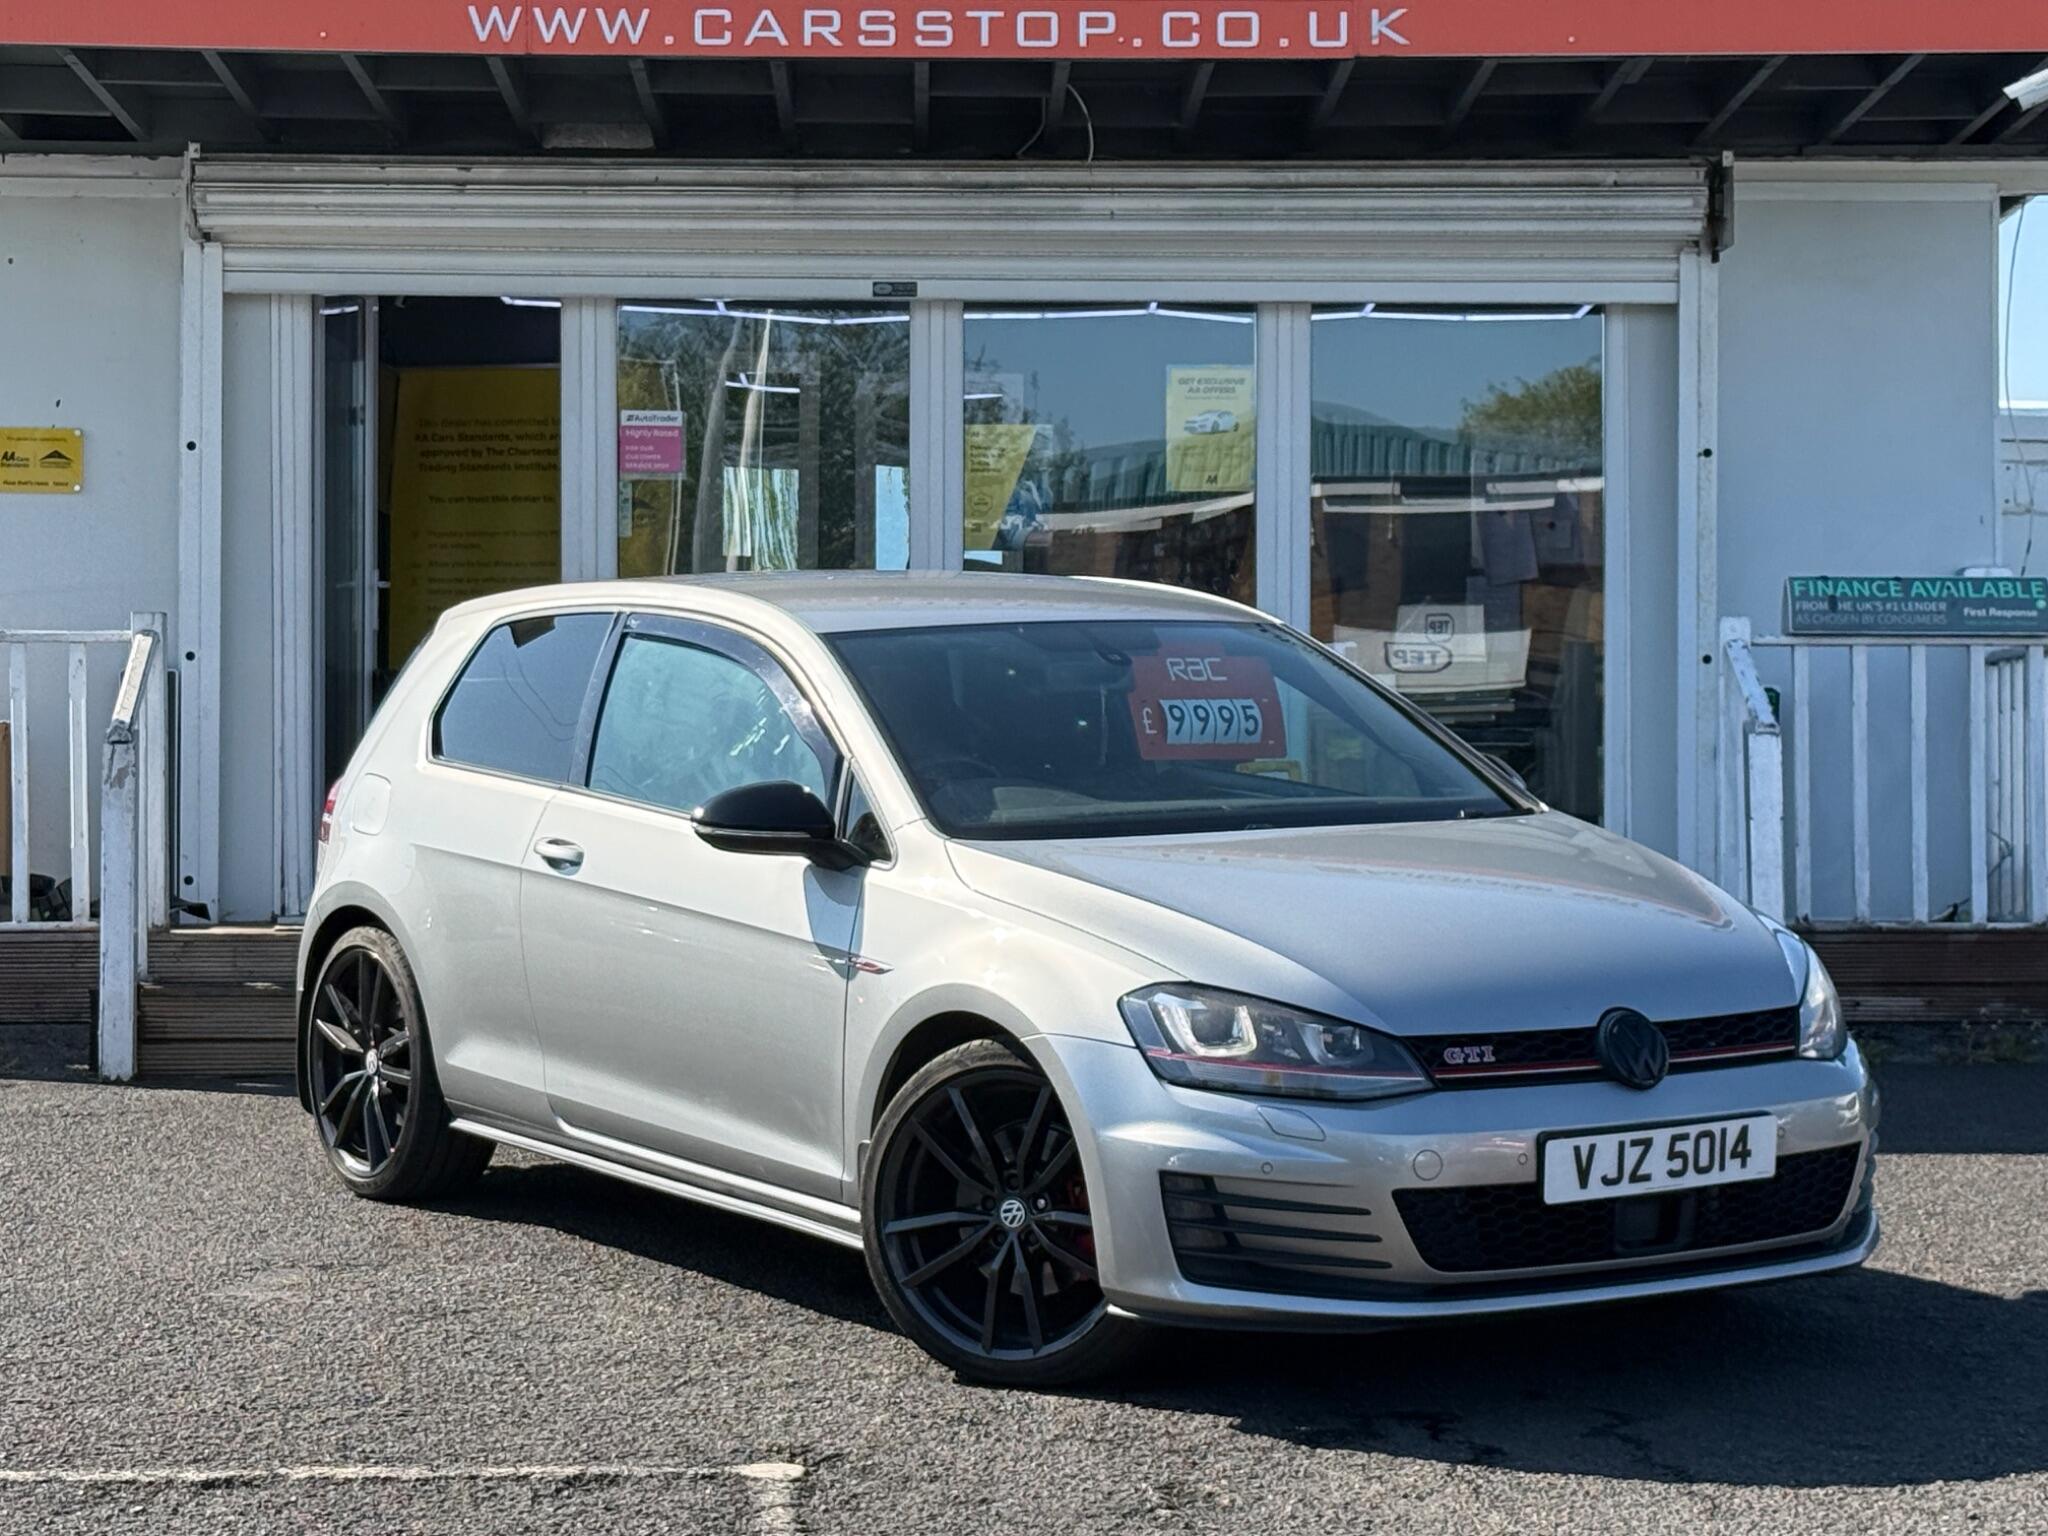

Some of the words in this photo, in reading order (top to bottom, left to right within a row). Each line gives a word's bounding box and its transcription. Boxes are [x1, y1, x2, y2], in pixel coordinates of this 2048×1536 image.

[467, 5, 1409, 48] WWW.CARSSTOP.CO.UK
[431, 432, 455, 442] Cars
[457, 432, 513, 443] Standards,
[515, 432, 547, 442] which
[420, 447, 469, 459] approved
[471, 447, 483, 459] by
[486, 447, 505, 457] The
[418, 462, 457, 474] Trading
[459, 462, 512, 472] Standards
[1793, 580, 1904, 598] FINANCE
[1909, 580, 2047, 599] AVAILABLE
[1795, 600, 1829, 611] FROM
[1901, 601, 1947, 612] LENDER
[1963, 606, 1987, 618] First
[1988, 607, 2038, 619] Response
[1812, 613, 1859, 625] CHOSEN
[1861, 613, 1875, 625] BY
[1877, 613, 1947, 625] CONSUMERS
[1166, 703, 1260, 736] 9995
[1443, 1045, 1497, 1065] GTI
[1573, 1136, 1654, 1191] VJZ
[1666, 1124, 1753, 1179] 5014
